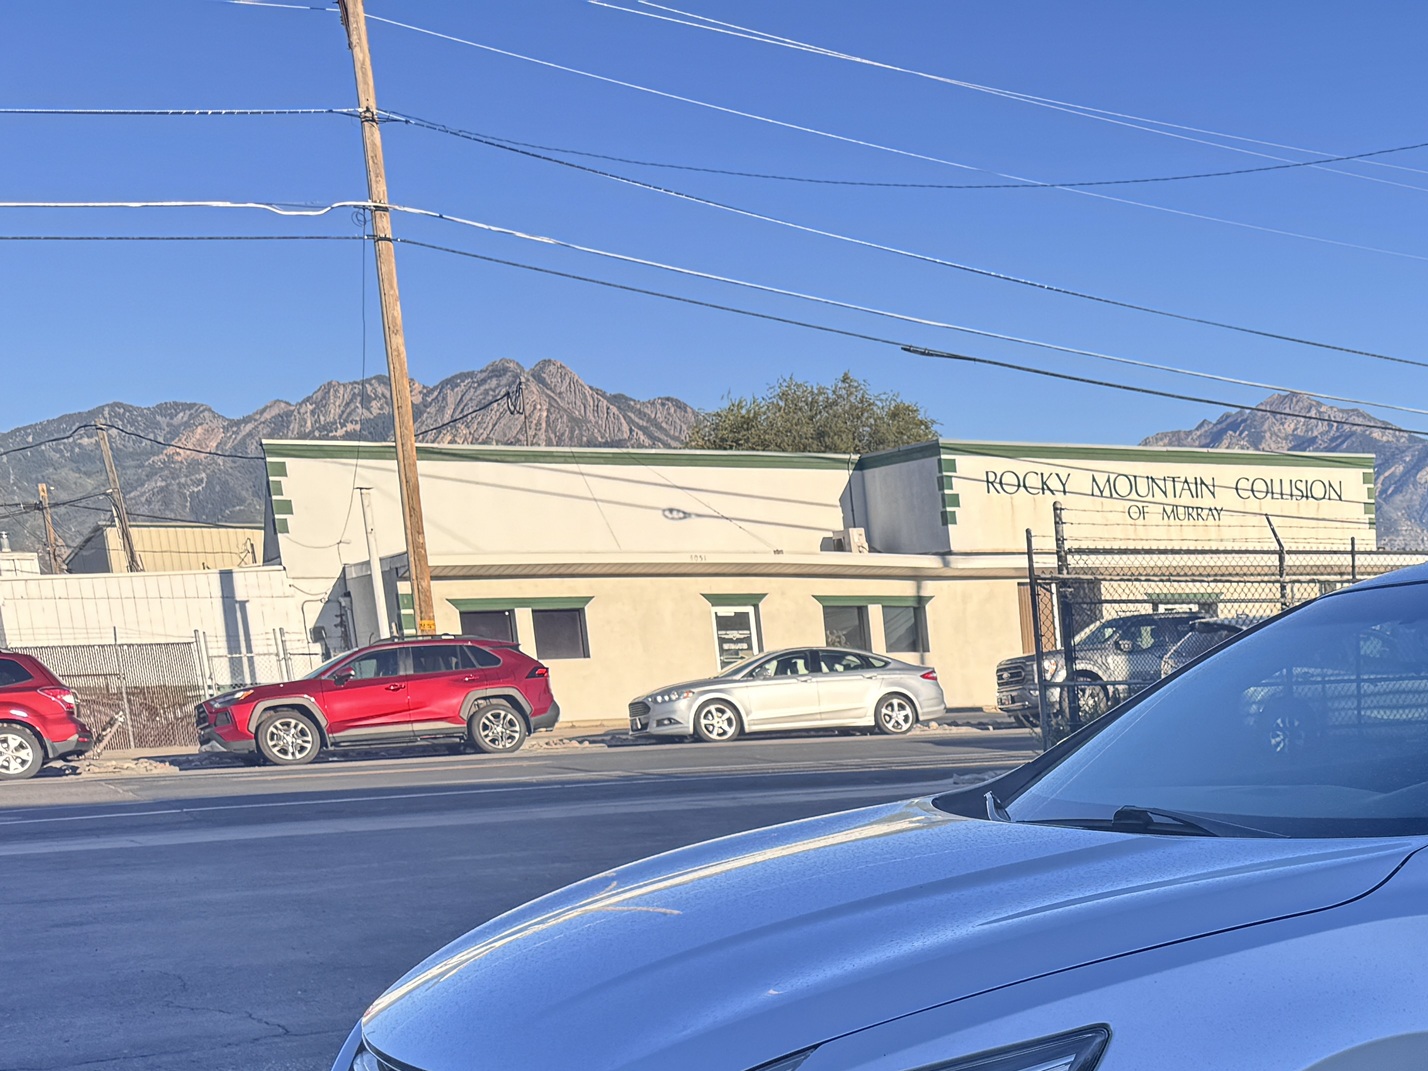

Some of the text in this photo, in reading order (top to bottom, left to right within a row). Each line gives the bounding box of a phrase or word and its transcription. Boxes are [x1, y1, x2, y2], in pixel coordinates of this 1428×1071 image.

[985, 470, 1343, 502] ROCKY MOUNTAIN COLLISION
[1127, 504, 1223, 522] OF MURRAY
